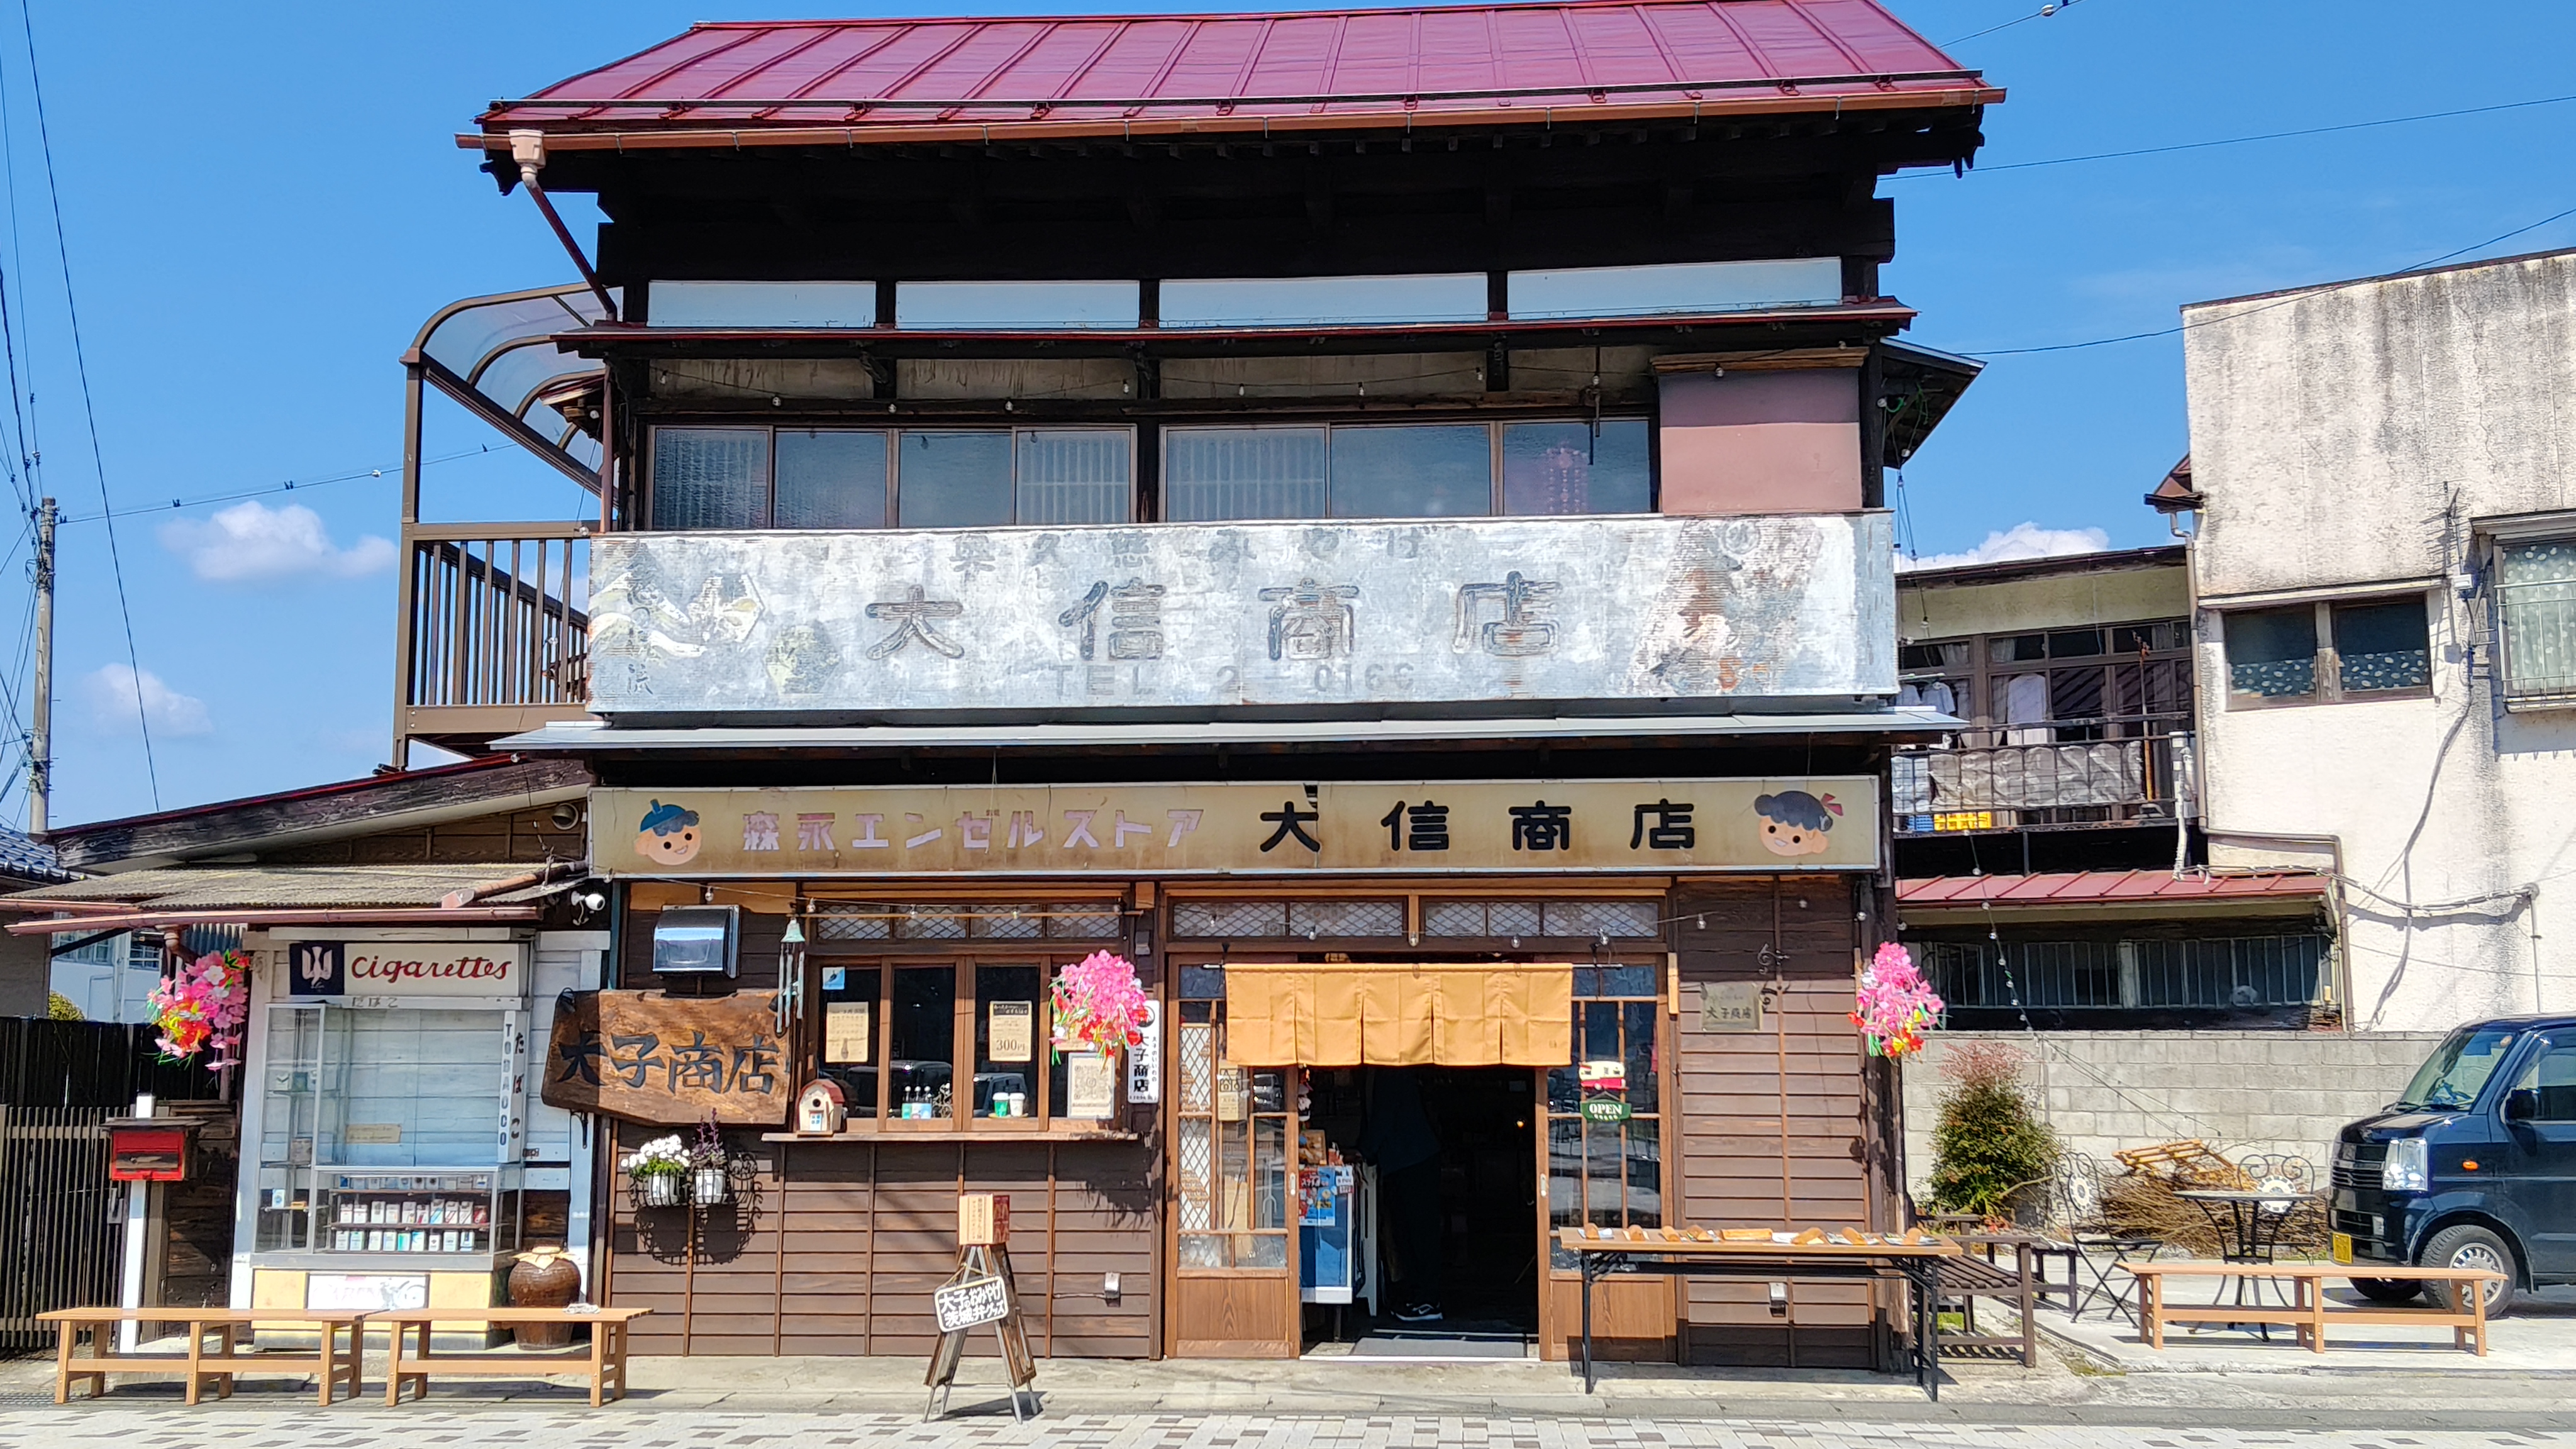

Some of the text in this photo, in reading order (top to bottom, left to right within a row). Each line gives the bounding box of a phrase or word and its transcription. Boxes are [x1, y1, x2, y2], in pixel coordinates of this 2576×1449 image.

[865, 570, 1562, 662] 大信商店
[1049, 664, 1157, 696] TEL
[742, 798, 1695, 852] 森永エンゼルストア 大信商店
[557, 1029, 781, 1096] 大子商店
[996, 1039, 1025, 1052] 300円
[499, 1023, 513, 1146] TOBACCO
[511, 1032, 525, 1140] たばこ
[1589, 1103, 1623, 1115] OPEN
